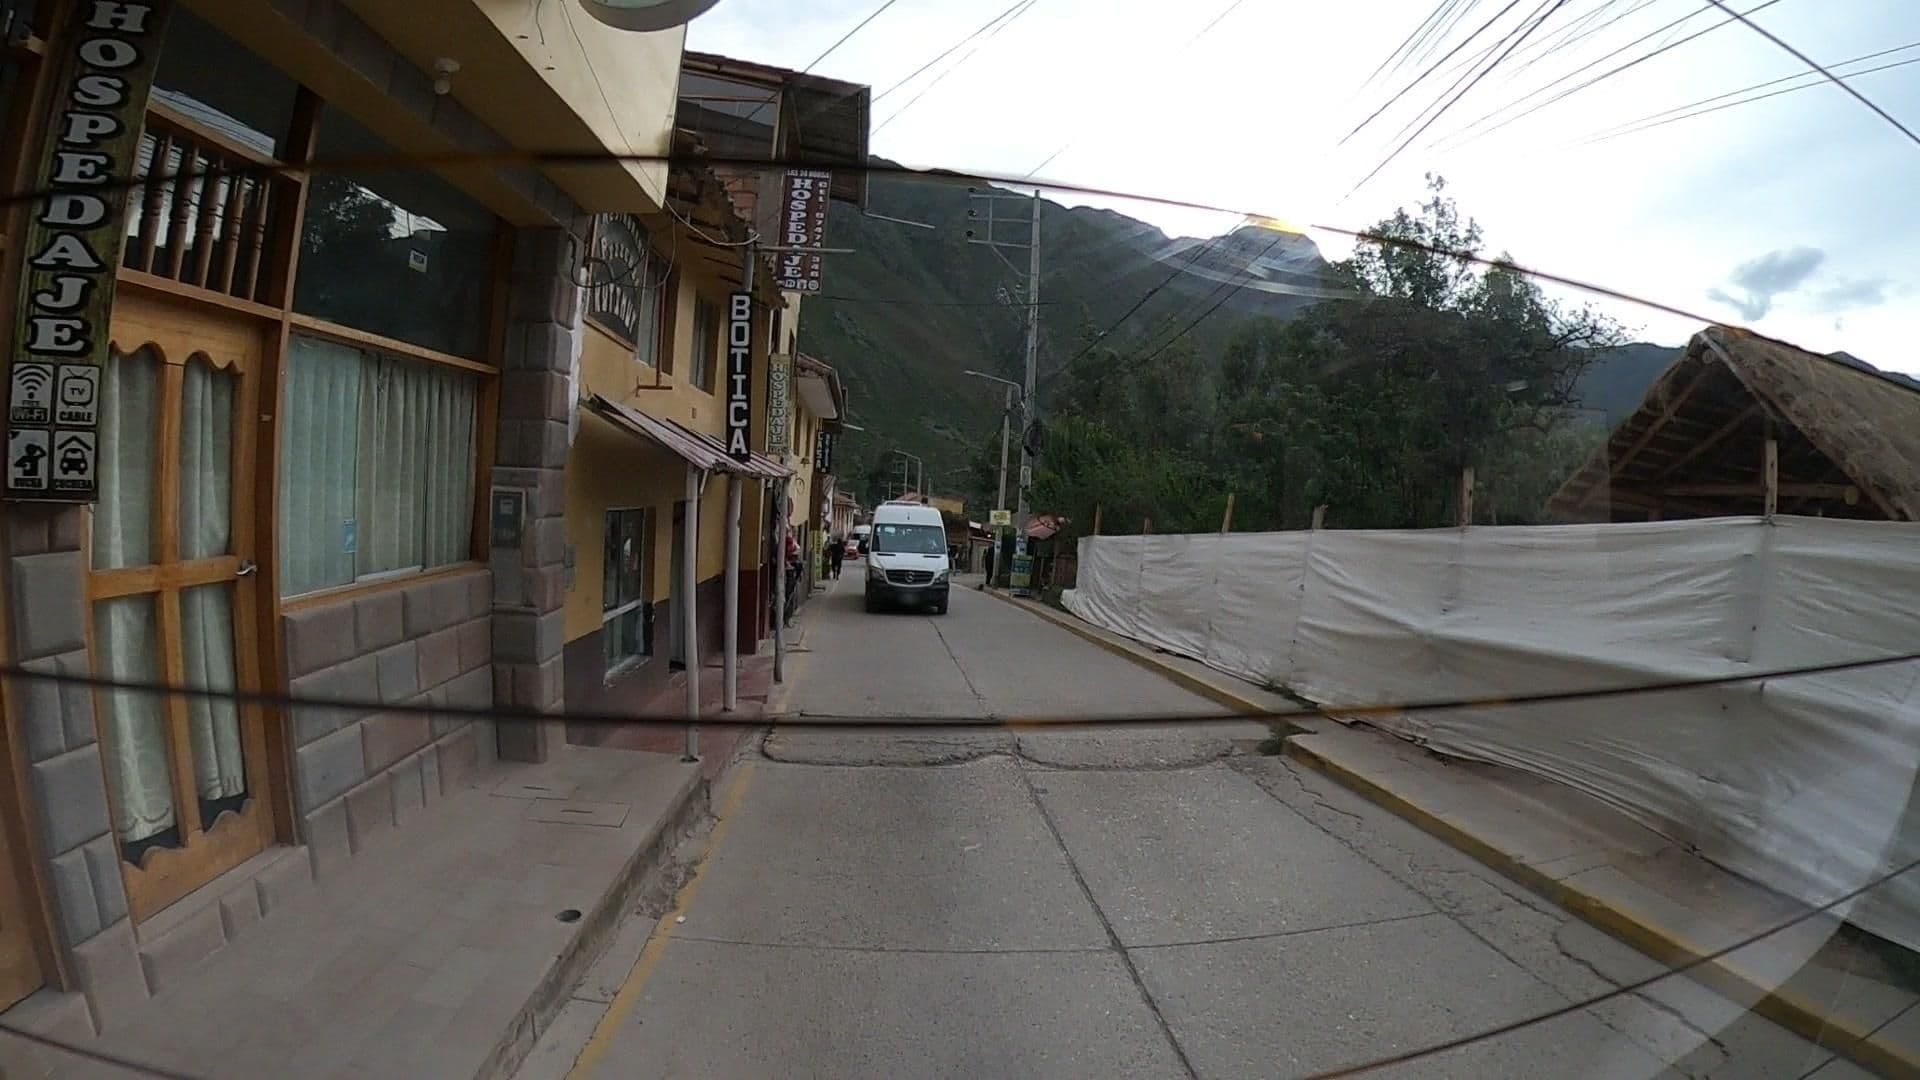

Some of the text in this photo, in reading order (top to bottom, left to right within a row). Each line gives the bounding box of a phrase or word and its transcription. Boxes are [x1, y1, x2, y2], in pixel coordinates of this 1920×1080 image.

[29, 0, 150, 351] HOSPEDAJE
[784, 179, 813, 277] HOSPEDAJE
[729, 295, 750, 454] BOTICA
[770, 363, 785, 443] HOSPEDAJE
